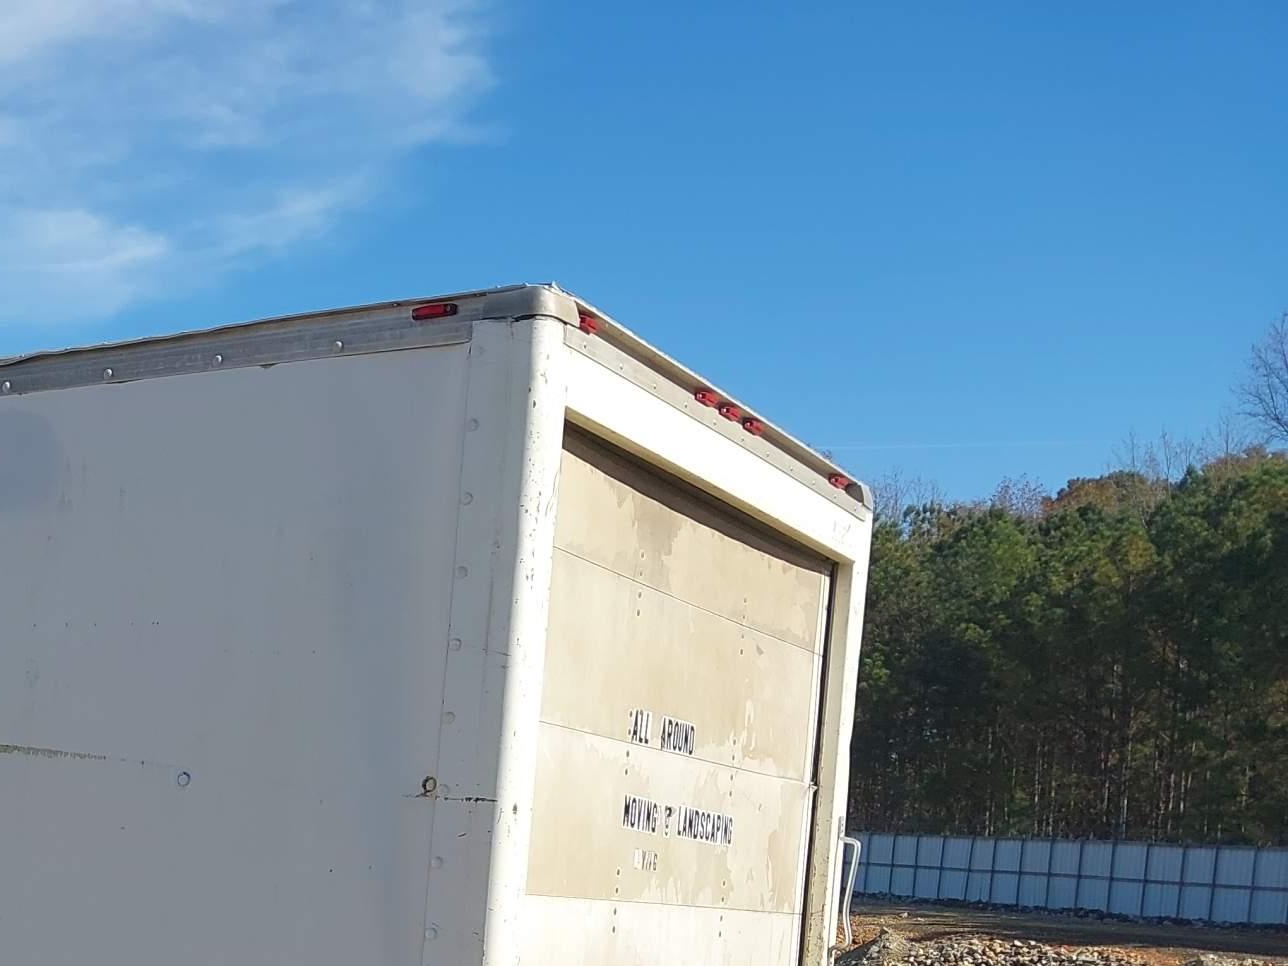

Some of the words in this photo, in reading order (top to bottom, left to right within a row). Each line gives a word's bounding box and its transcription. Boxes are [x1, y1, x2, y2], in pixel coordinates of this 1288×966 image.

[631, 709, 650, 745] ALL
[661, 717, 695, 756] AROUND
[623, 794, 658, 833] MOVING
[677, 805, 733, 845] LANDSCAPING
